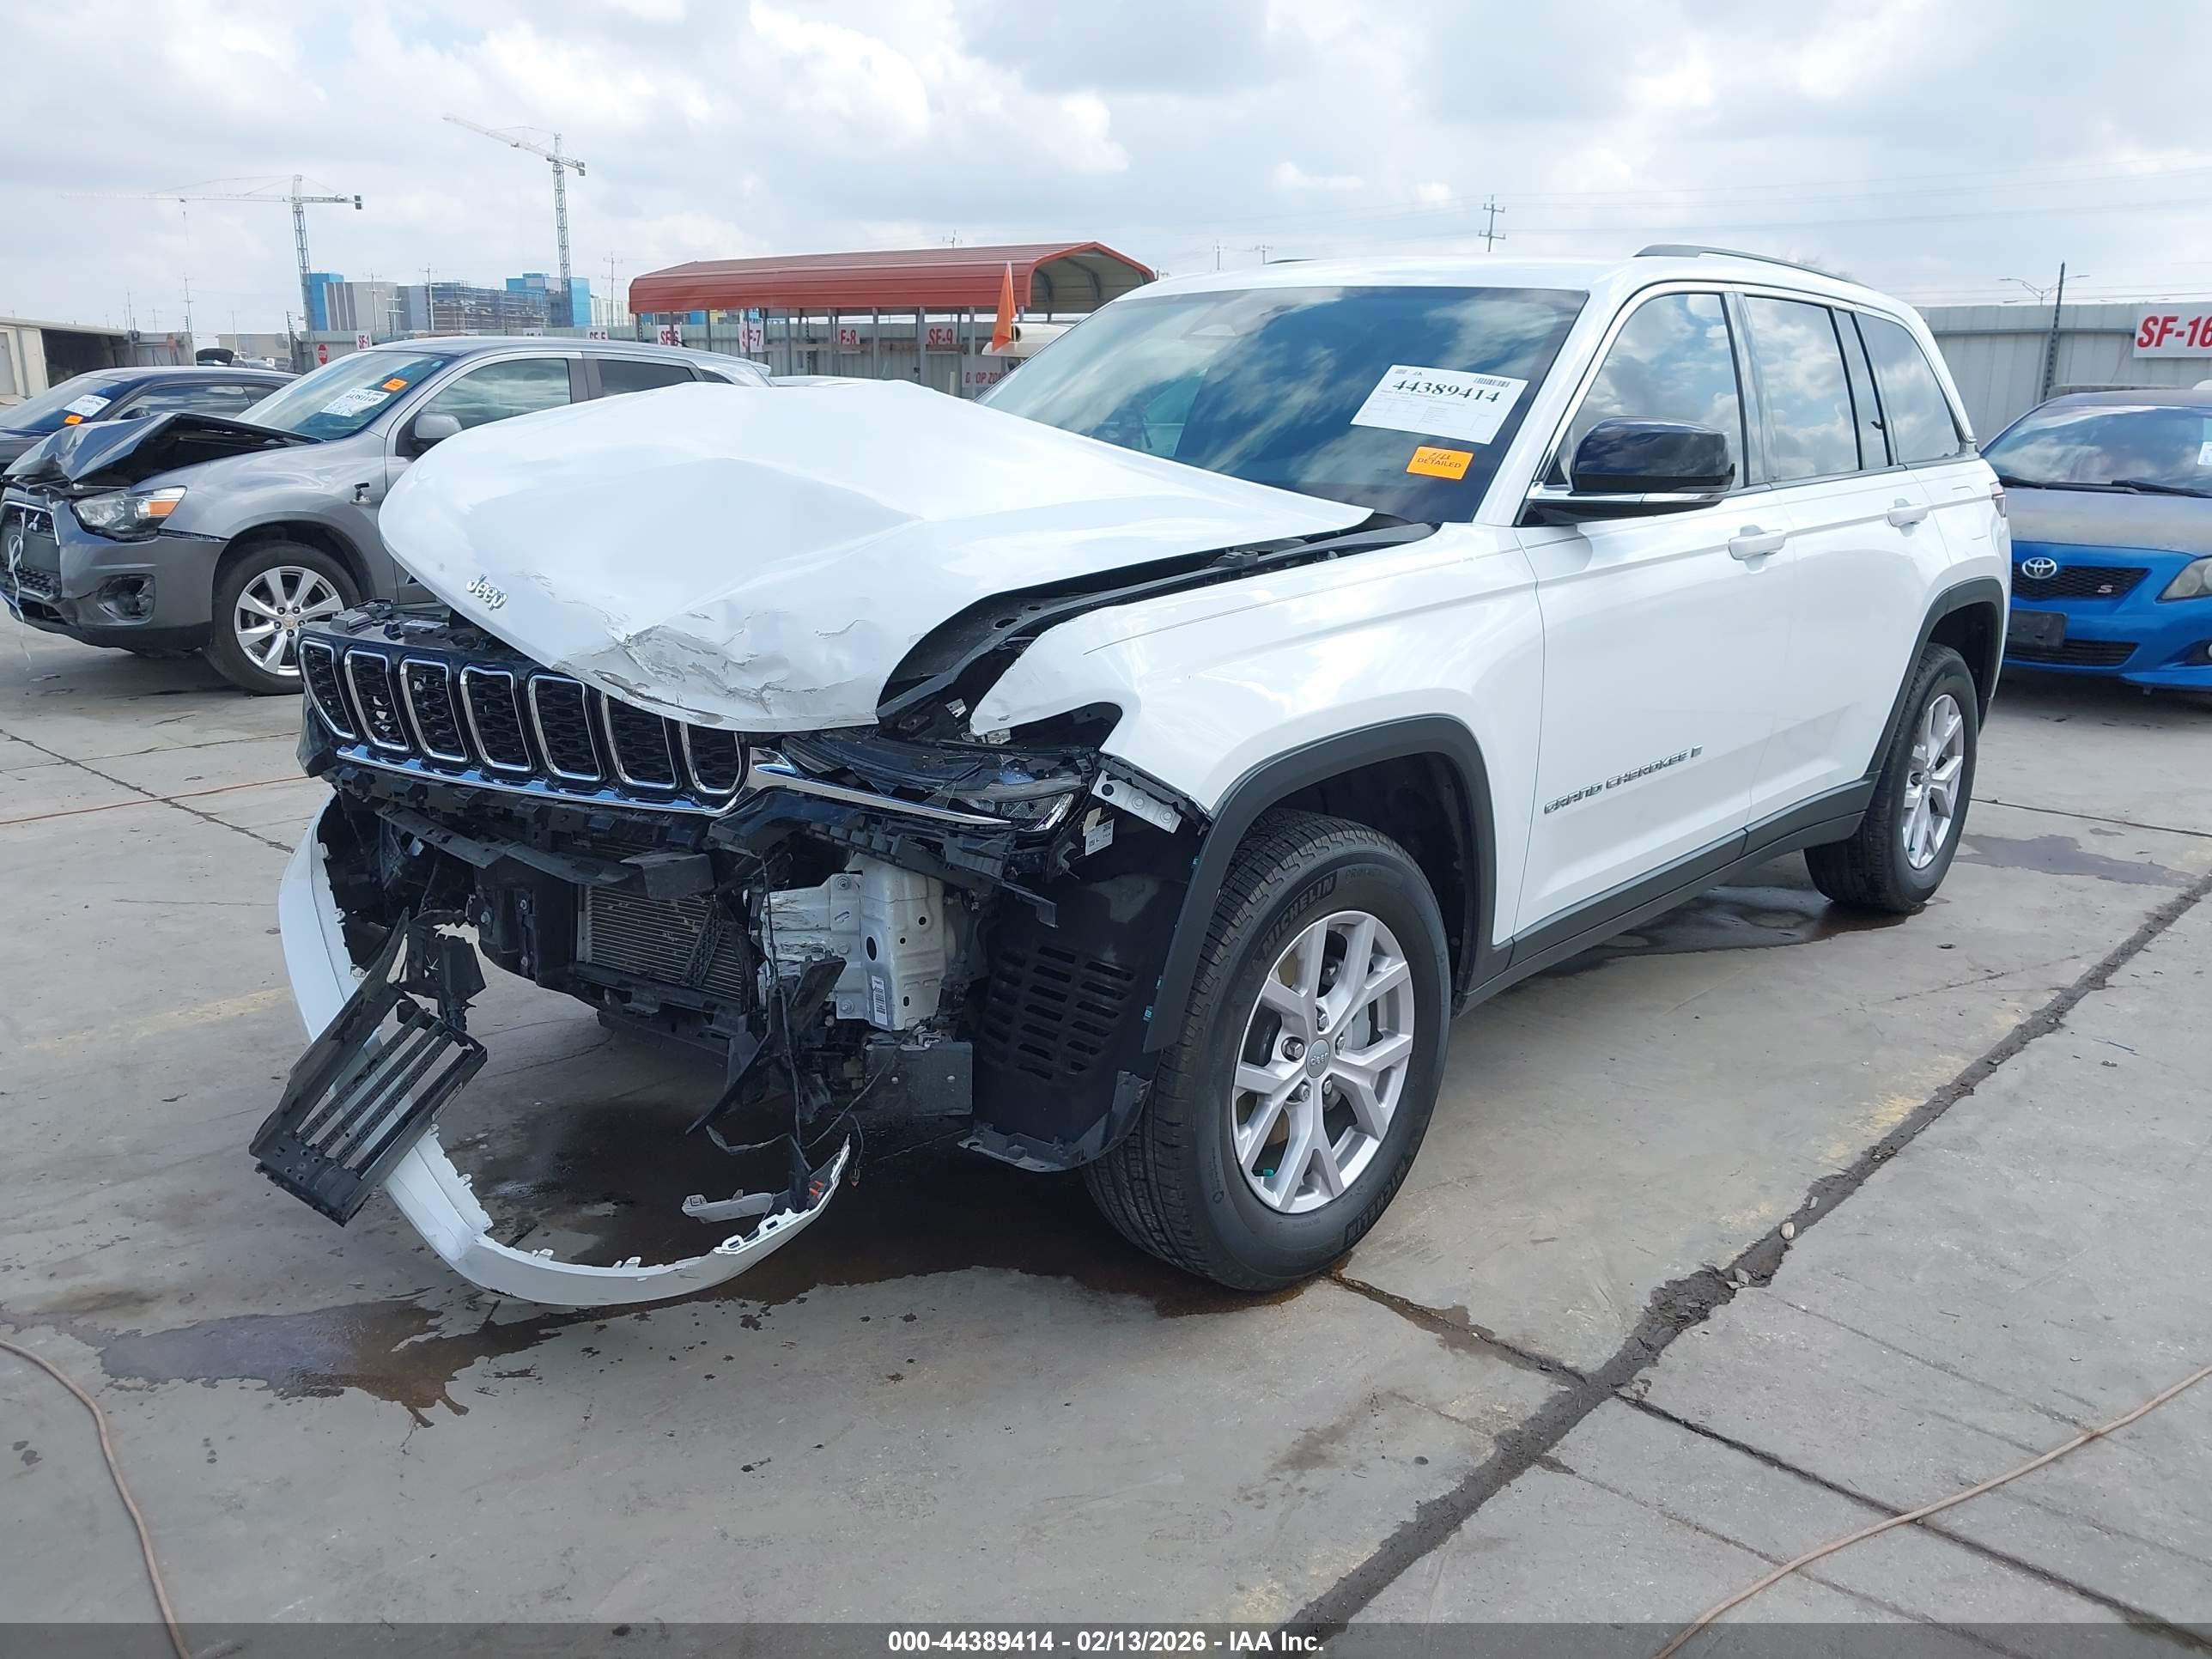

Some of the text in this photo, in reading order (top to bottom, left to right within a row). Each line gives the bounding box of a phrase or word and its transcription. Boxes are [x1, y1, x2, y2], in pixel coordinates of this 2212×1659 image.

[928, 328, 953, 344] SF-9
[2137, 315, 2212, 348] SF-16
[964, 371, 987, 384] DOP
[1392, 380, 1501, 403] 44389414
[1417, 457, 1462, 469] DETAILED
[466, 574, 508, 611] Jeep
[2097, 585, 2113, 593] S
[1544, 749, 1691, 815] GRAND CHEROKEE
[1261, 875, 1335, 957] MICHELIN
